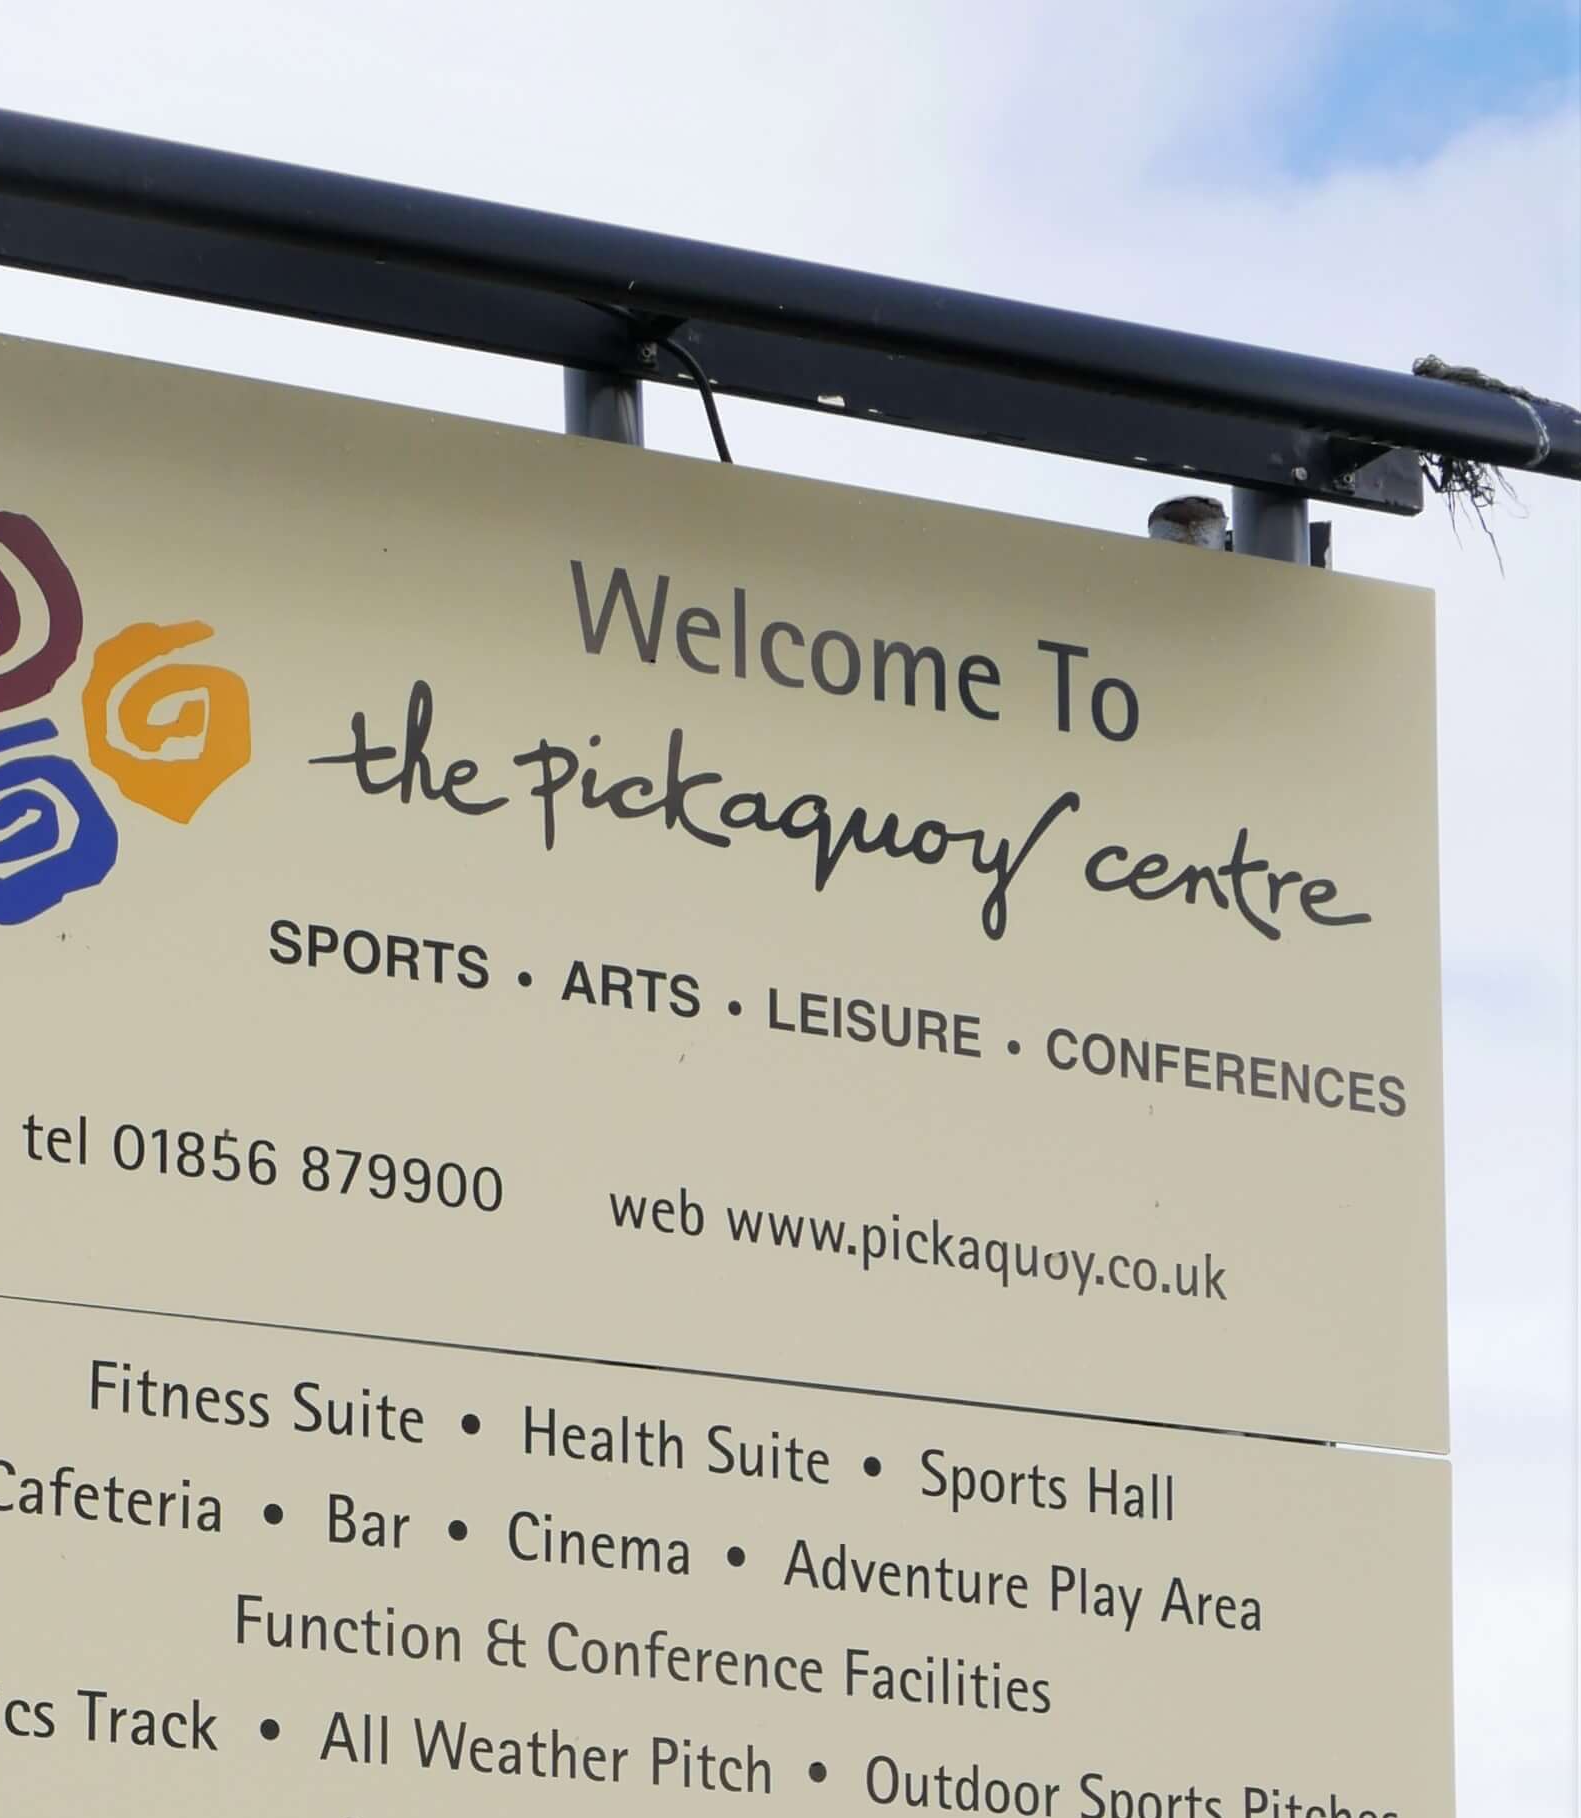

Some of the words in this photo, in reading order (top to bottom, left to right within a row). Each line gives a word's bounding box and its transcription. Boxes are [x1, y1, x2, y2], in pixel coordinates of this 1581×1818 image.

[569, 559, 1001, 721] Welcome
[1037, 639, 1140, 742] To
[307, 679, 510, 816] the
[512, 727, 1081, 941] pickaquoy
[1084, 827, 1372, 941] centre
[269, 919, 489, 990] SPORTS
[561, 959, 701, 1018] ARTS
[768, 987, 982, 1059] LEISURE
[1046, 1027, 1406, 1118] CONFERENCES
[22, 1114, 87, 1165] tel
[113, 1124, 277, 1186] 01856
[302, 1145, 503, 1212] 879900
[609, 1187, 704, 1237] web
[726, 1207, 1228, 1301] www.pickaquoy.co.uk
[91, 1359, 270, 1429] Fitness
[293, 1381, 424, 1444] Suite
[524, 1405, 683, 1469] Health
[707, 1424, 830, 1485] Suite
[921, 1448, 1067, 1513] Sports
[1089, 1466, 1173, 1521] Hall
[328, 1493, 411, 1549] Bar
[508, 1510, 689, 1576] Cinema
[783, 1539, 1028, 1609] Adventure
[1051, 1564, 1143, 1633] Play
[1160, 1576, 1261, 1632] Area
[237, 1593, 461, 1662] Function
[486, 1618, 527, 1669] &
[547, 1621, 823, 1694] Conference
[846, 1648, 1051, 1714] Facilities
[76, 1689, 218, 1751] Track
[319, 1711, 388, 1765] All
[413, 1717, 629, 1783] Weather
[652, 1736, 771, 1795] Pitch
[866, 1755, 1060, 1818] Outdoor
